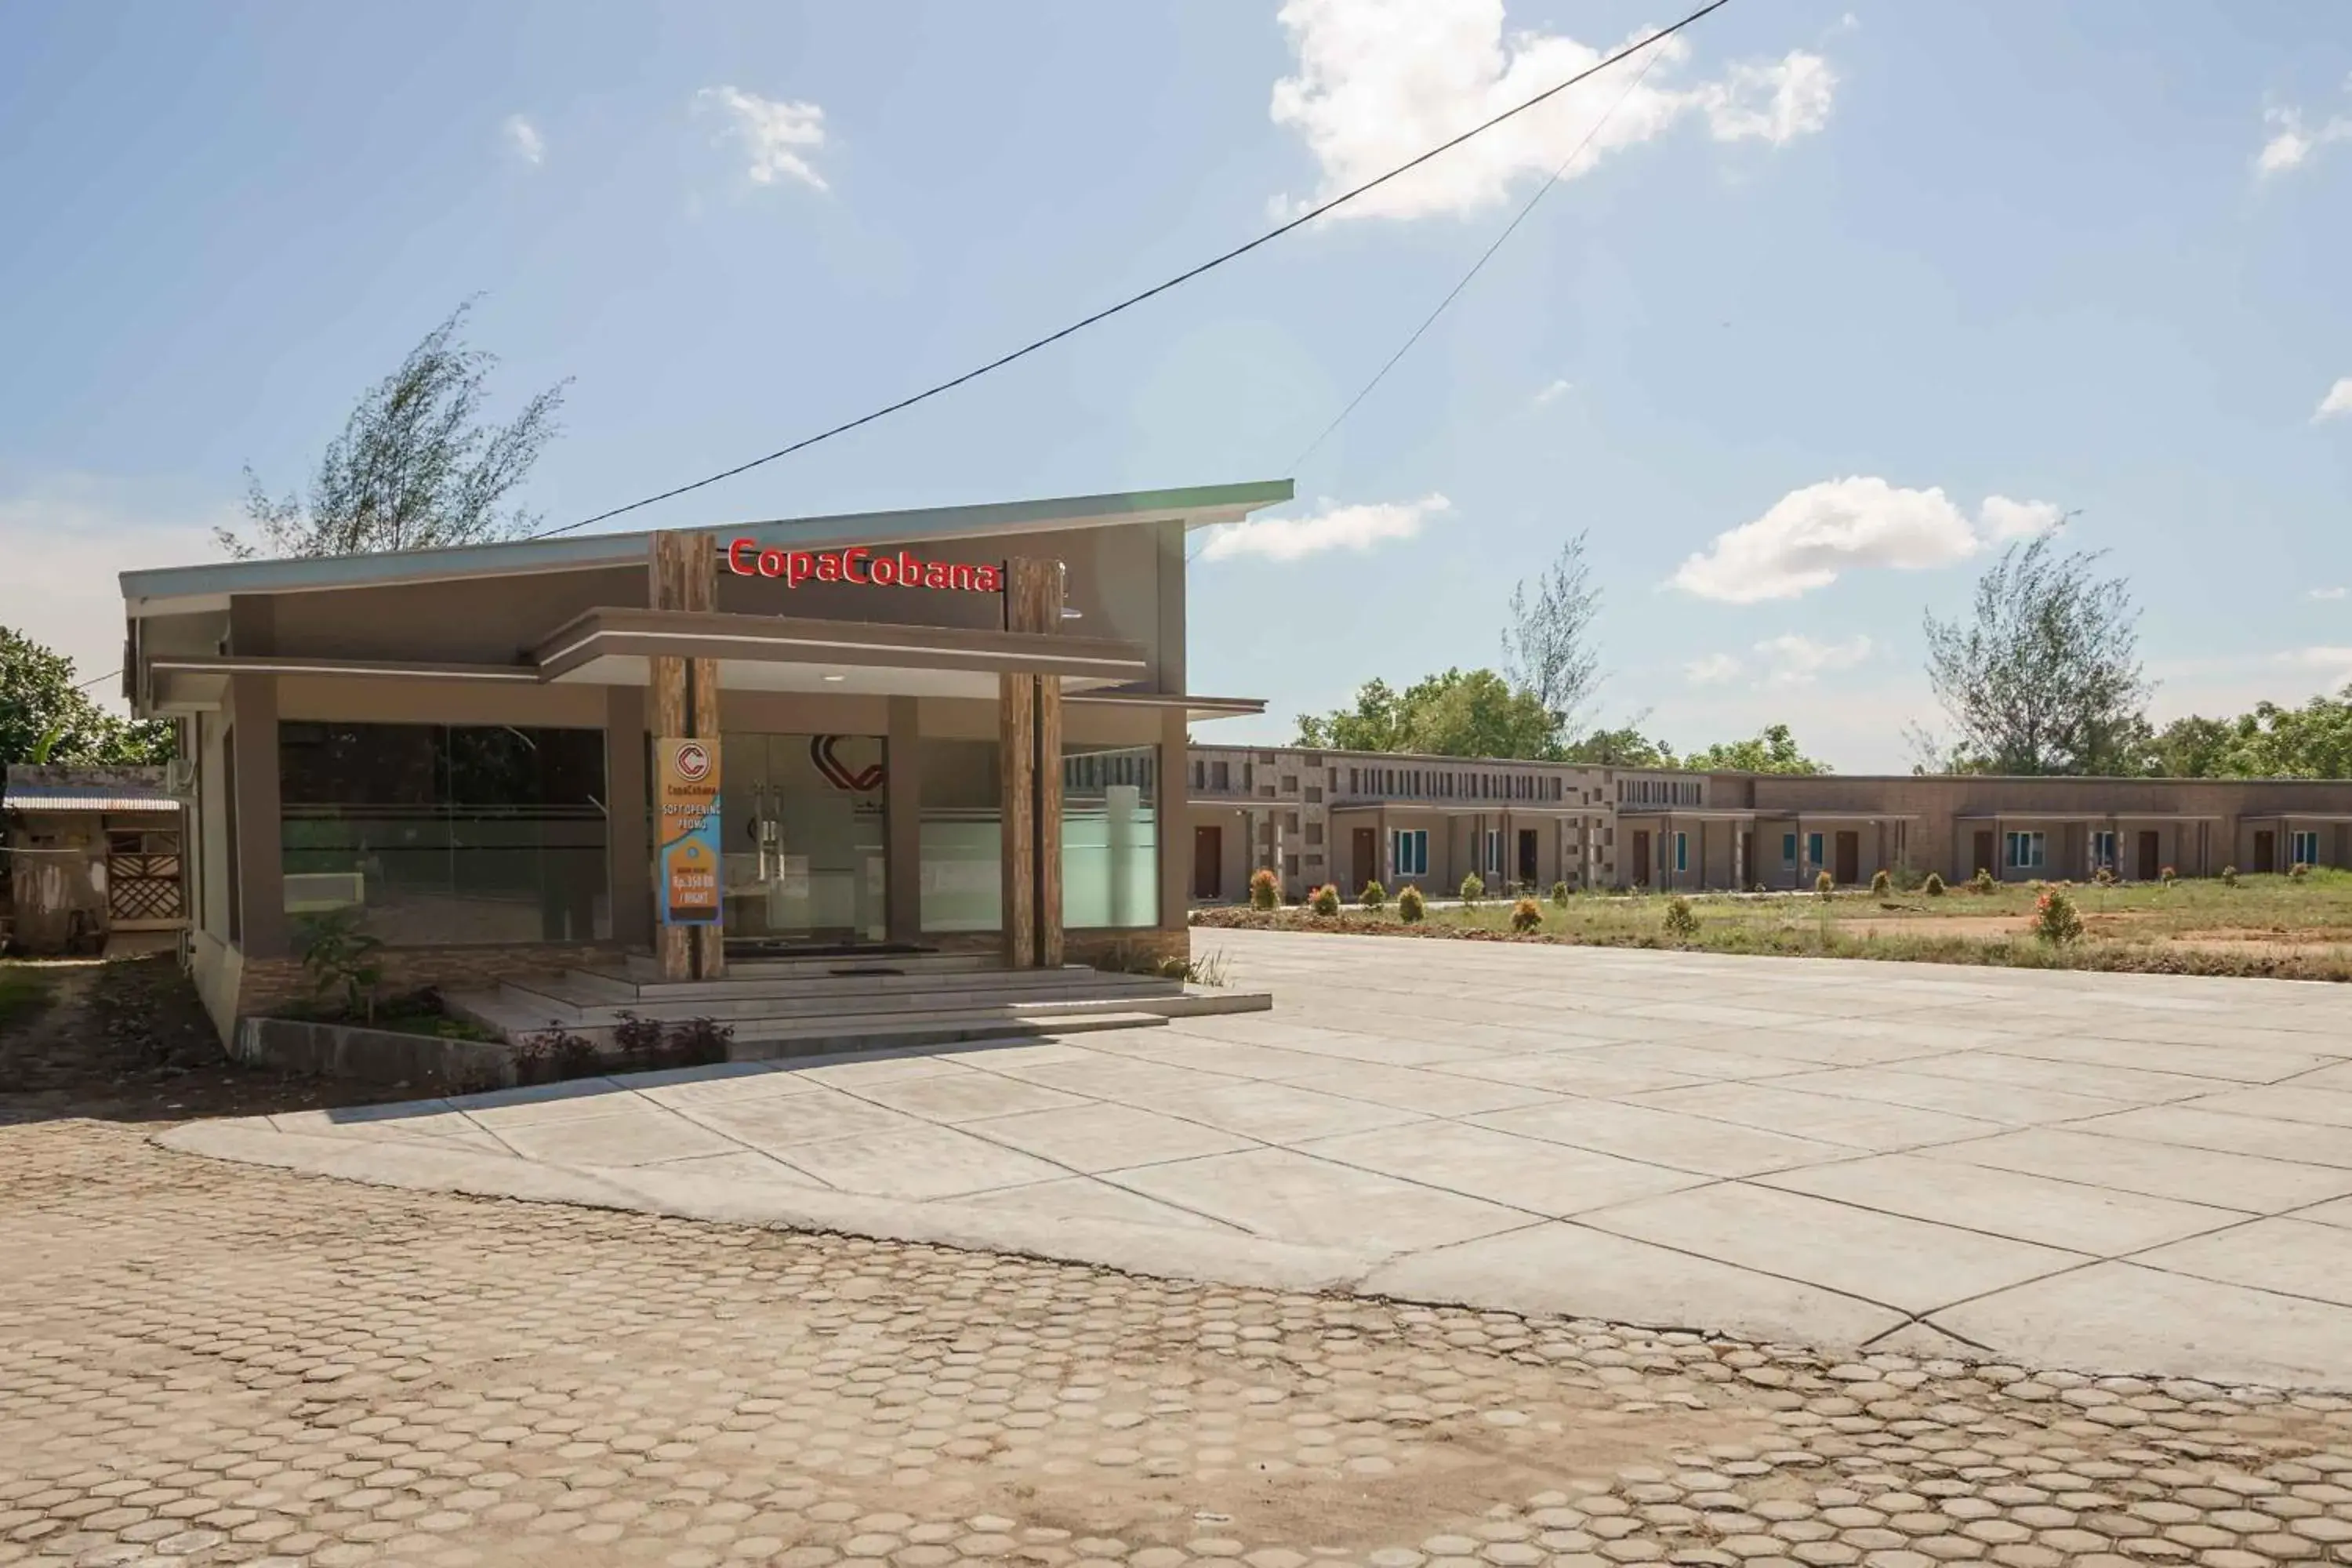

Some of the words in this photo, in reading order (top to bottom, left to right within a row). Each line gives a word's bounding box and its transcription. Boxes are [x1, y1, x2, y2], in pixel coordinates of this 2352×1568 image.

[728, 537, 1000, 591] CopaCobana
[664, 804, 684, 815] SOFT
[685, 804, 720, 815] OPENING
